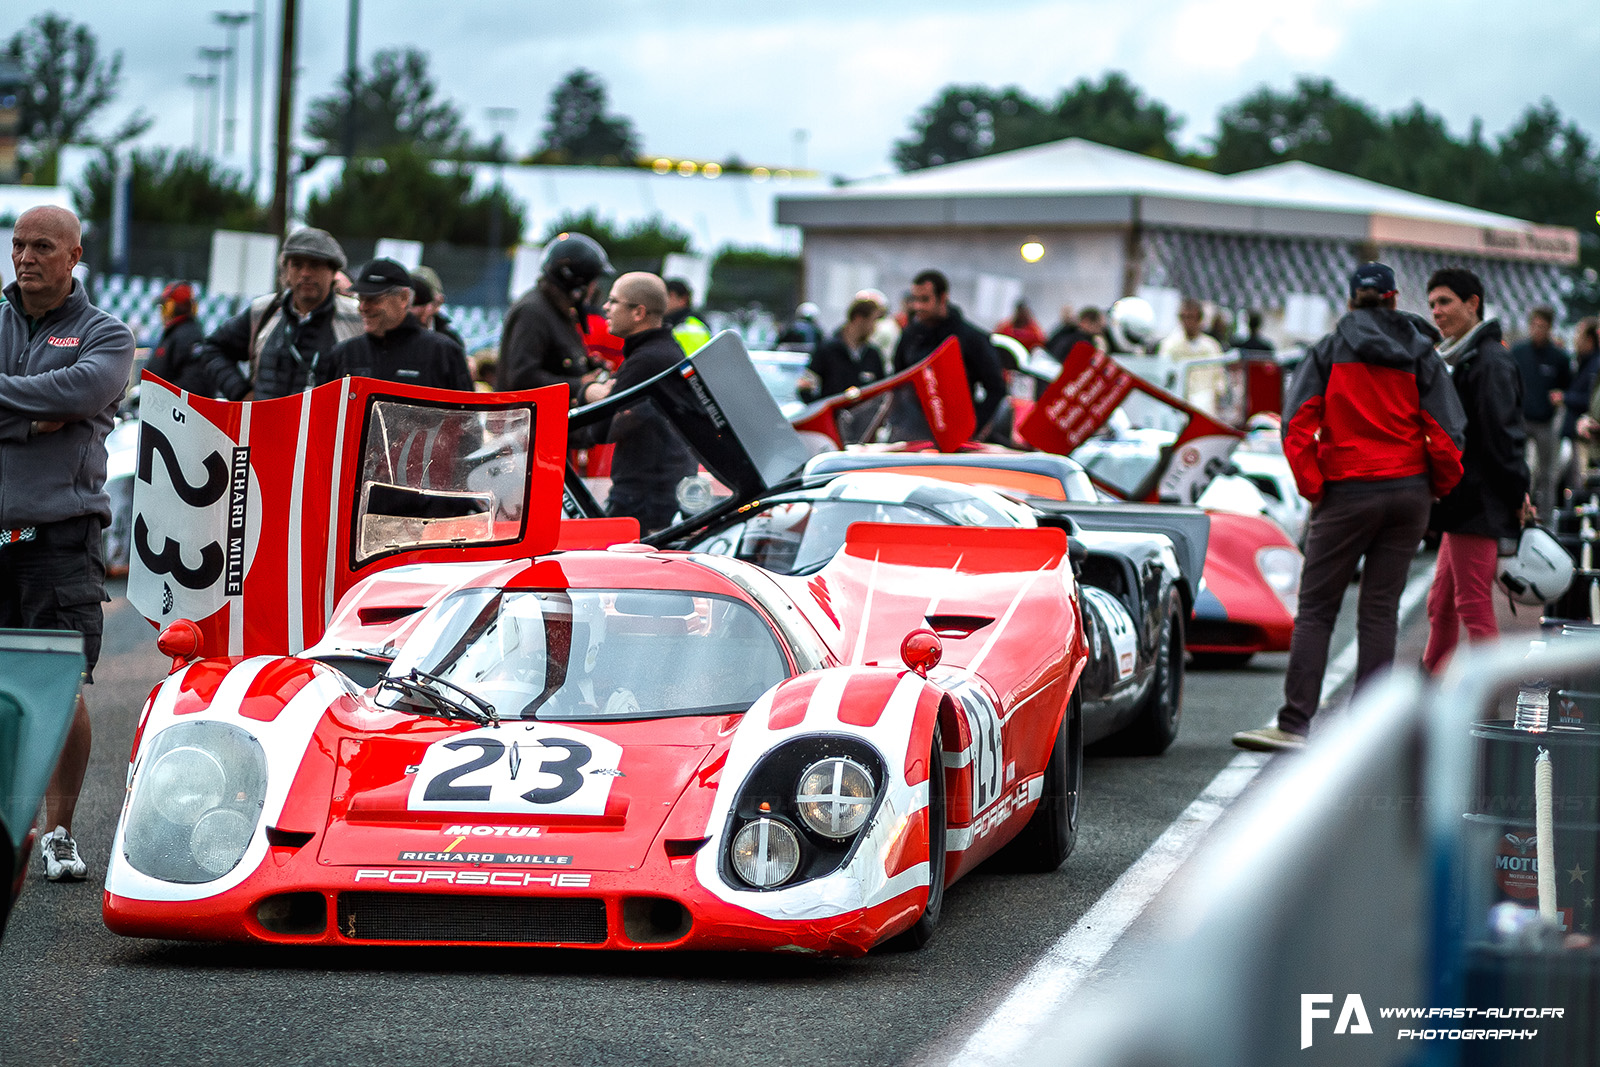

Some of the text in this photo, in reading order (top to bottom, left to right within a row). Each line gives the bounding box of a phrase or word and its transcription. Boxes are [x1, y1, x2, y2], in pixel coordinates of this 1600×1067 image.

[172, 407, 186, 424] 5
[134, 420, 230, 590] 23
[227, 450, 248, 593] RICHARD MILLE
[406, 764, 420, 774] 5
[423, 737, 592, 805] 23
[443, 825, 542, 838] MOTUL
[402, 852, 569, 865] RICHARD MILLE
[1495, 856, 1538, 872] MOTU
[354, 869, 592, 888] PORSCHE
